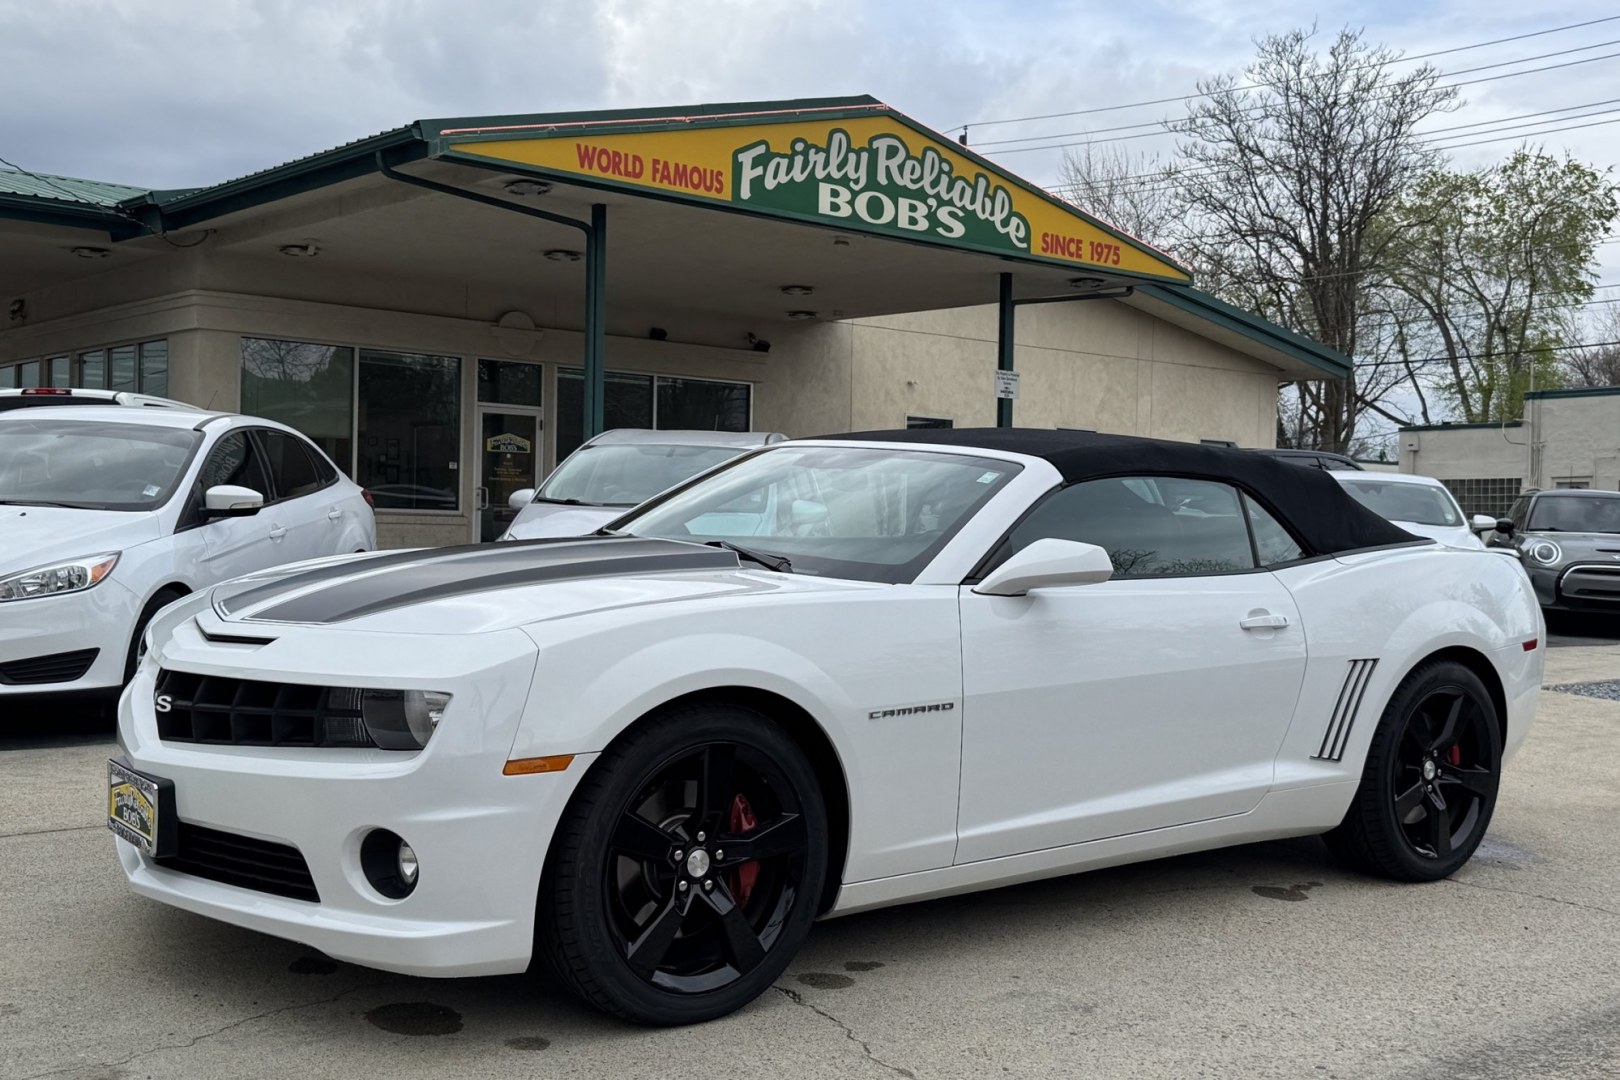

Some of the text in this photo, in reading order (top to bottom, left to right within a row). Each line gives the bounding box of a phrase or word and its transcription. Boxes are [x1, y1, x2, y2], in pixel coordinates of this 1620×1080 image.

[576, 143, 724, 194] WORLD FAMOUS
[738, 131, 1028, 248] Fairly Reliable
[817, 182, 966, 239] BOB'S
[1041, 231, 1121, 266] SINCE 1975
[868, 702, 954, 719] CAMARO
